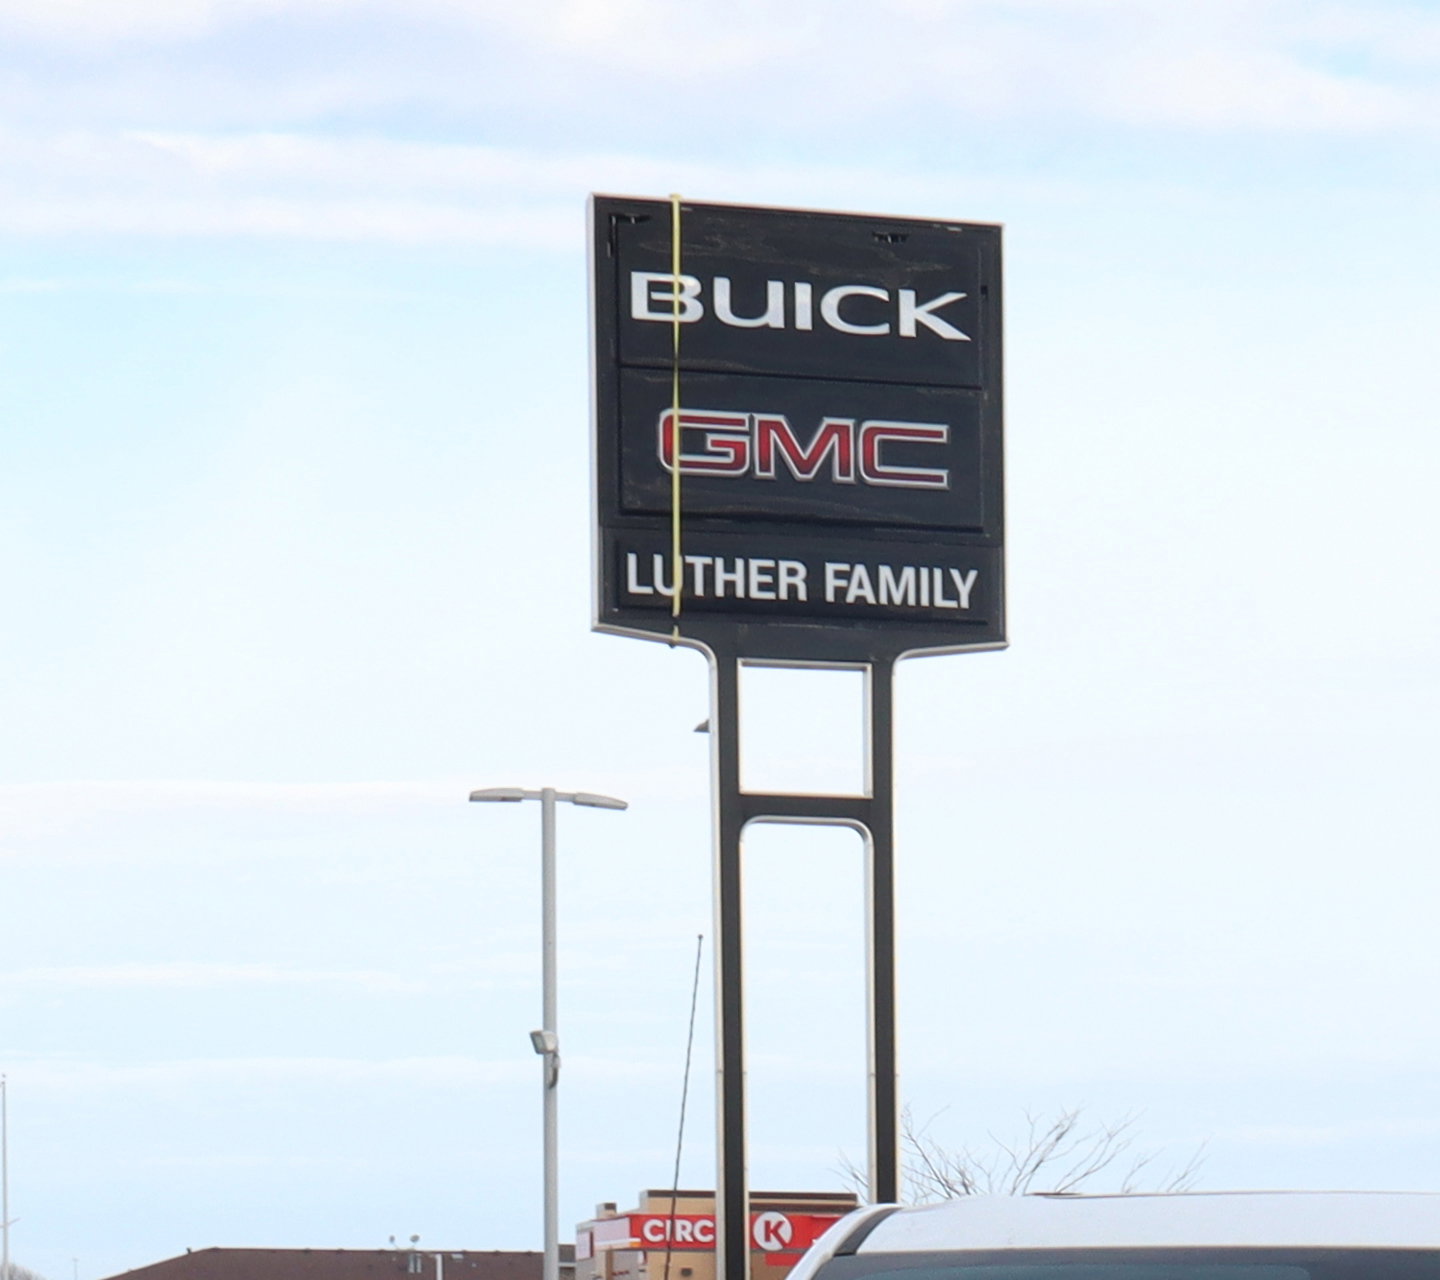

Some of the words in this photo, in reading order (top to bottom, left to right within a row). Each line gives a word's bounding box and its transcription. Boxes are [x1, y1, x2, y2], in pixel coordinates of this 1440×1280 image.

[630, 271, 971, 341] BUICK
[658, 408, 949, 489] GMC
[626, 552, 807, 601] LUTHER
[825, 562, 978, 609] FAMILY
[643, 1219, 714, 1243] CIRC
